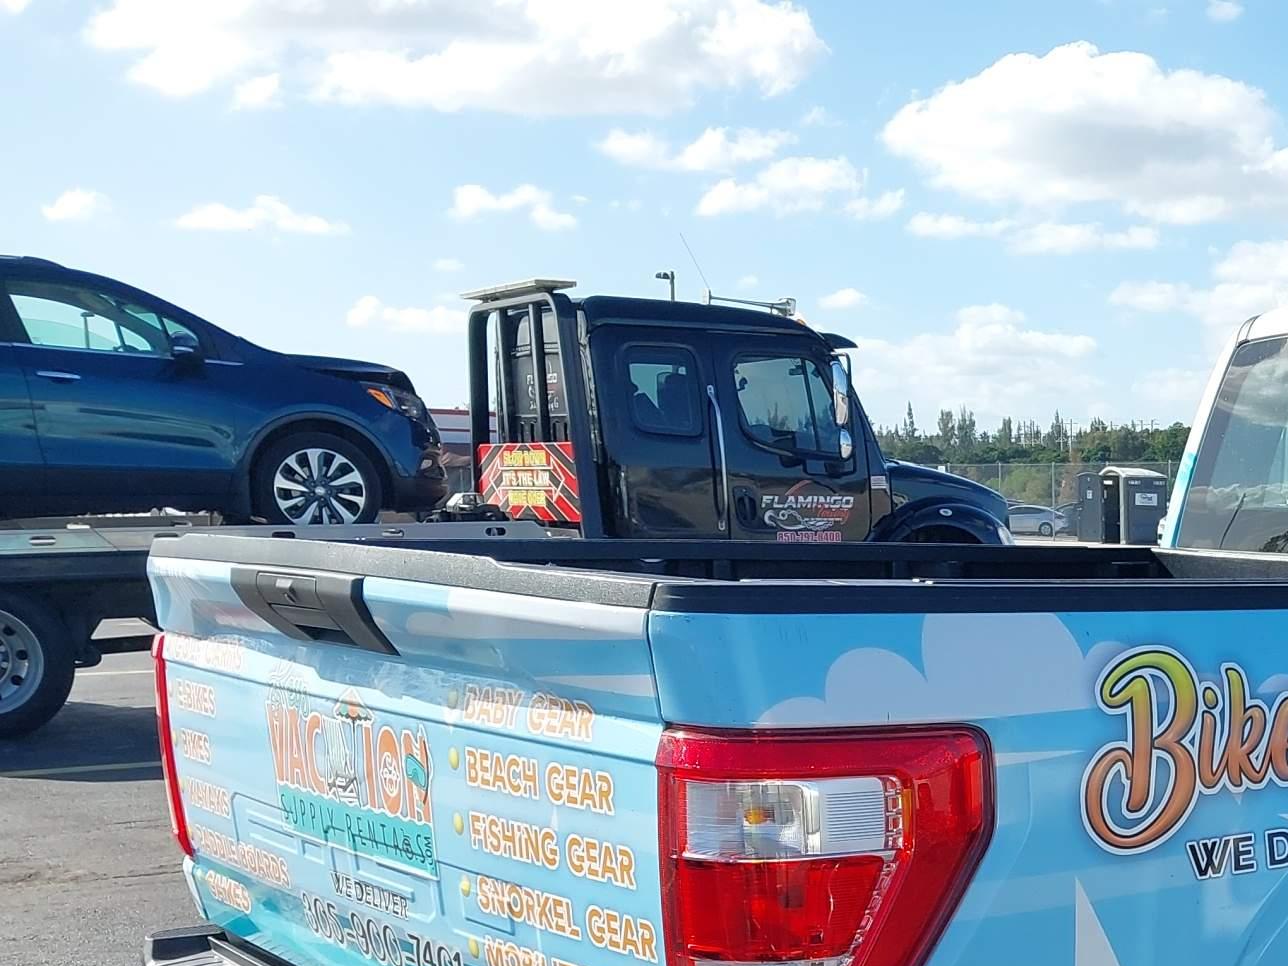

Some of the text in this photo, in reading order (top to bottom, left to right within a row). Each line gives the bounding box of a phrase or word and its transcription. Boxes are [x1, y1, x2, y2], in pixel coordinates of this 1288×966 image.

[518, 471, 532, 486] THE
[761, 495, 854, 509] FLAMINGO
[463, 684, 596, 743] BABY GEAR
[464, 745, 615, 816] BEACH GEAR
[279, 792, 339, 837] SUPPLY
[468, 810, 637, 890] FISHING GEAR
[1185, 833, 1256, 881] WE
[329, 870, 409, 921] WE DELIVER
[476, 875, 659, 965] SNORKEL GEAR
